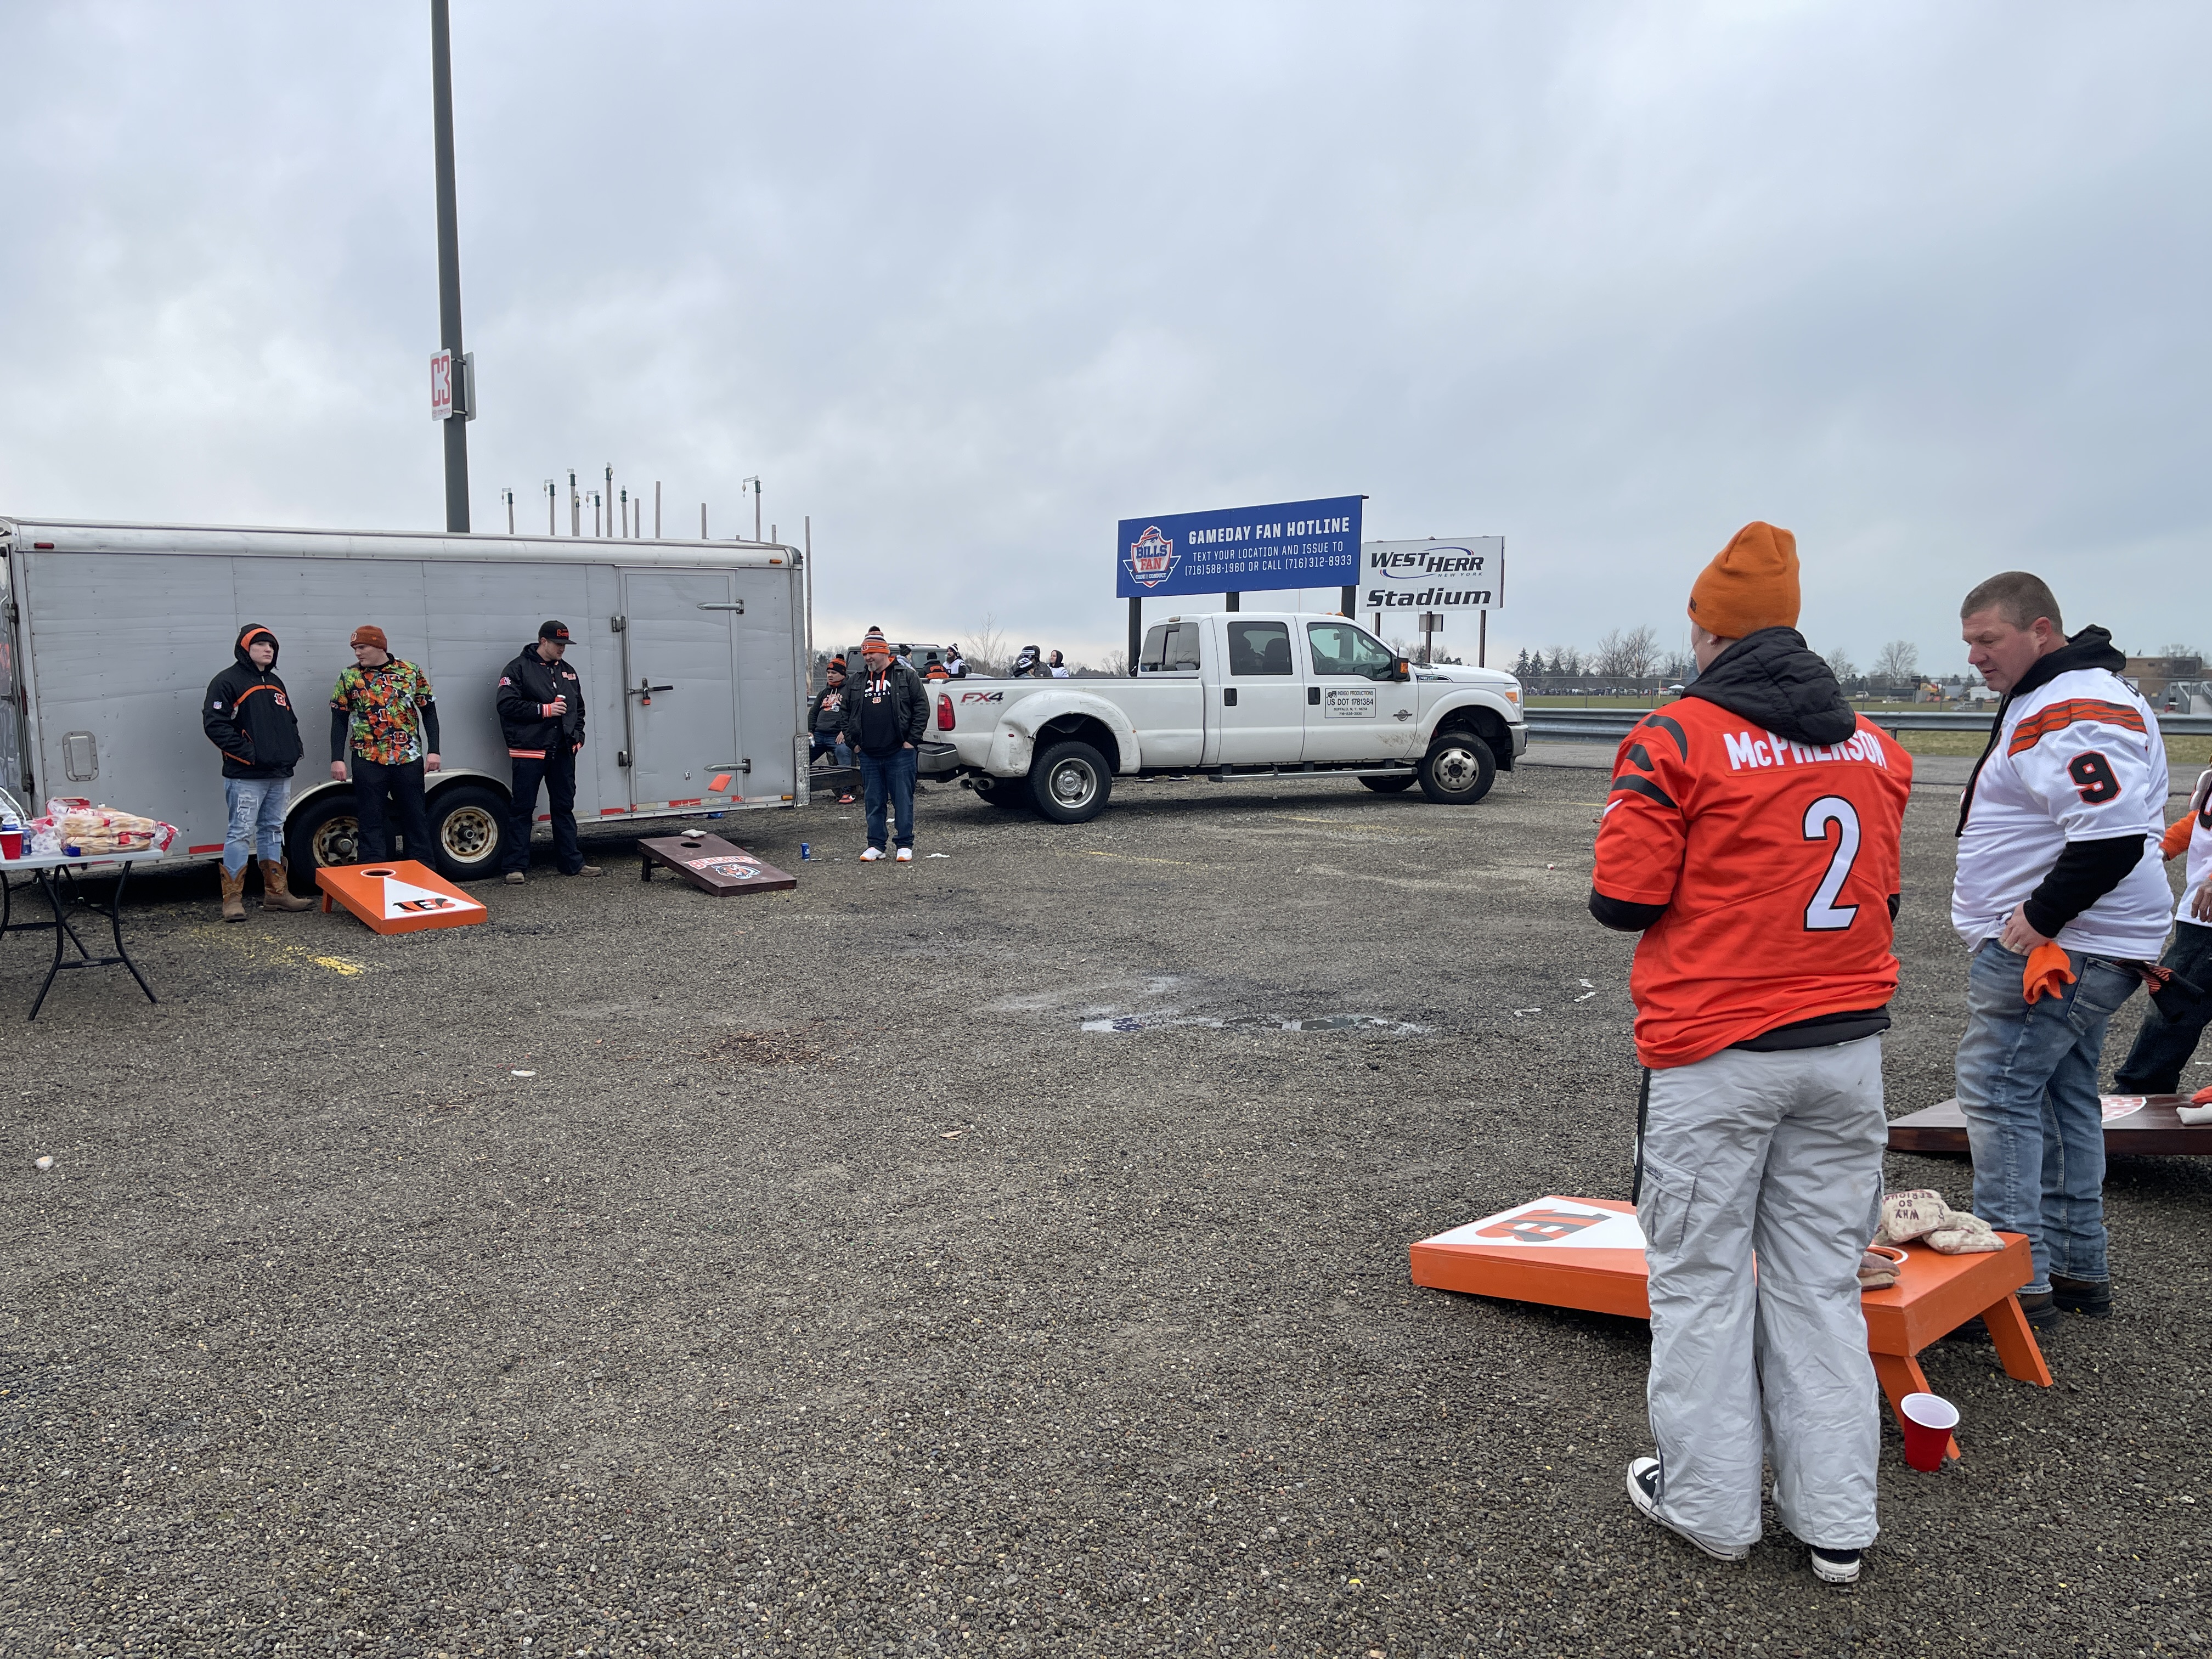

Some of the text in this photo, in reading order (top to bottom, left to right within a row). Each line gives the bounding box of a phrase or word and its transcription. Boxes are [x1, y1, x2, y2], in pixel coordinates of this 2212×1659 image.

[431, 355, 450, 407] C3
[1189, 517, 1350, 545] GAMEDAY FAN HOTLINE
[1136, 544, 1167, 559] BILLS
[1193, 541, 1343, 562] TEXT YOUR LOCATION AND ISSUE TO
[1371, 551, 1430, 568] WEST
[1141, 557, 1162, 571] FAN
[1248, 561, 1259, 572] OR
[1262, 560, 1282, 571] CALL
[1425, 556, 1485, 572] HERR
[1366, 588, 1491, 607] Stadium
[960, 691, 1004, 703] FX4
[2067, 750, 2123, 806] 9
[684, 856, 761, 870] BENGALS
[1802, 794, 1861, 932] 2
[1898, 1199, 1913, 1207] SO
[1895, 1209, 1920, 1221] WHY
